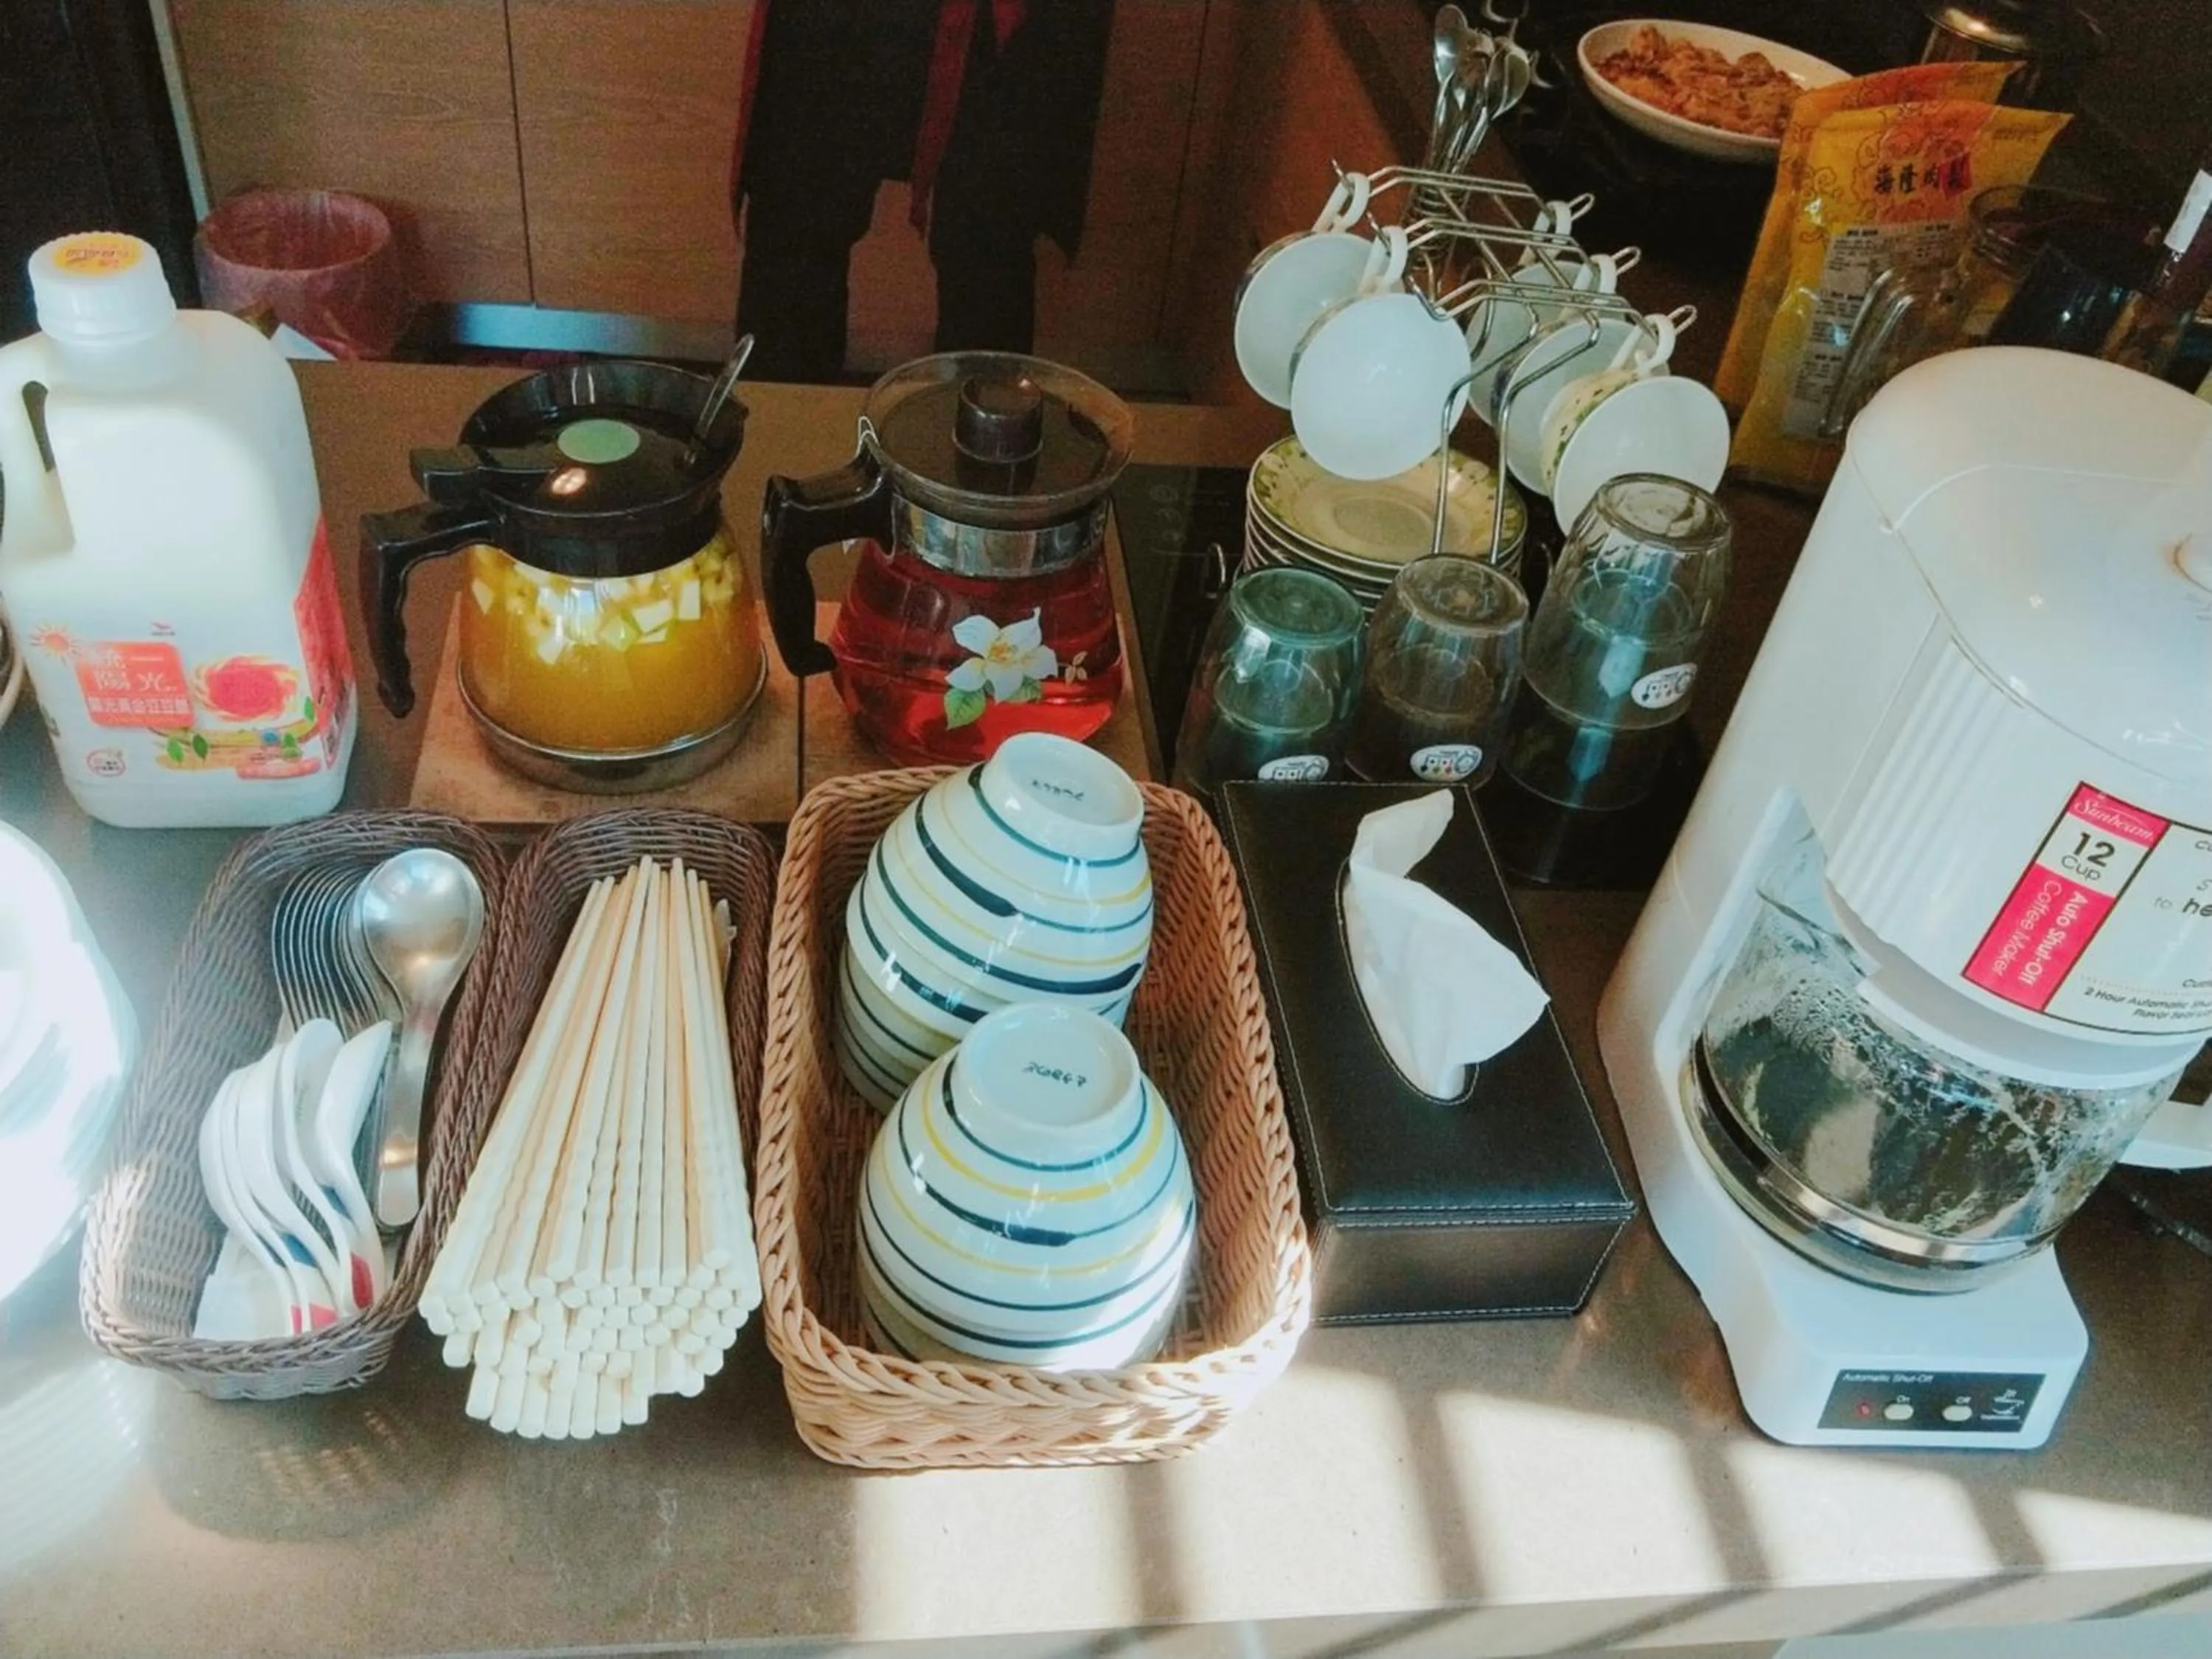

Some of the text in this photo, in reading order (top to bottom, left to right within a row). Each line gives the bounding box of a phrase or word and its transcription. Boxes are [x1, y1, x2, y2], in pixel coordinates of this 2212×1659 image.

[2073, 831, 2115, 868] 12
[2061, 854, 2101, 881] Cup
[1991, 880, 2062, 977] Coffee Maker
[2017, 890, 2089, 986] Auto Shut-Off
[2084, 987, 2095, 996] 2
[2095, 990, 2126, 1004] Hour
[1843, 1373, 1935, 1383] Automatic Shut-Off
[1896, 1394, 1910, 1403] On
